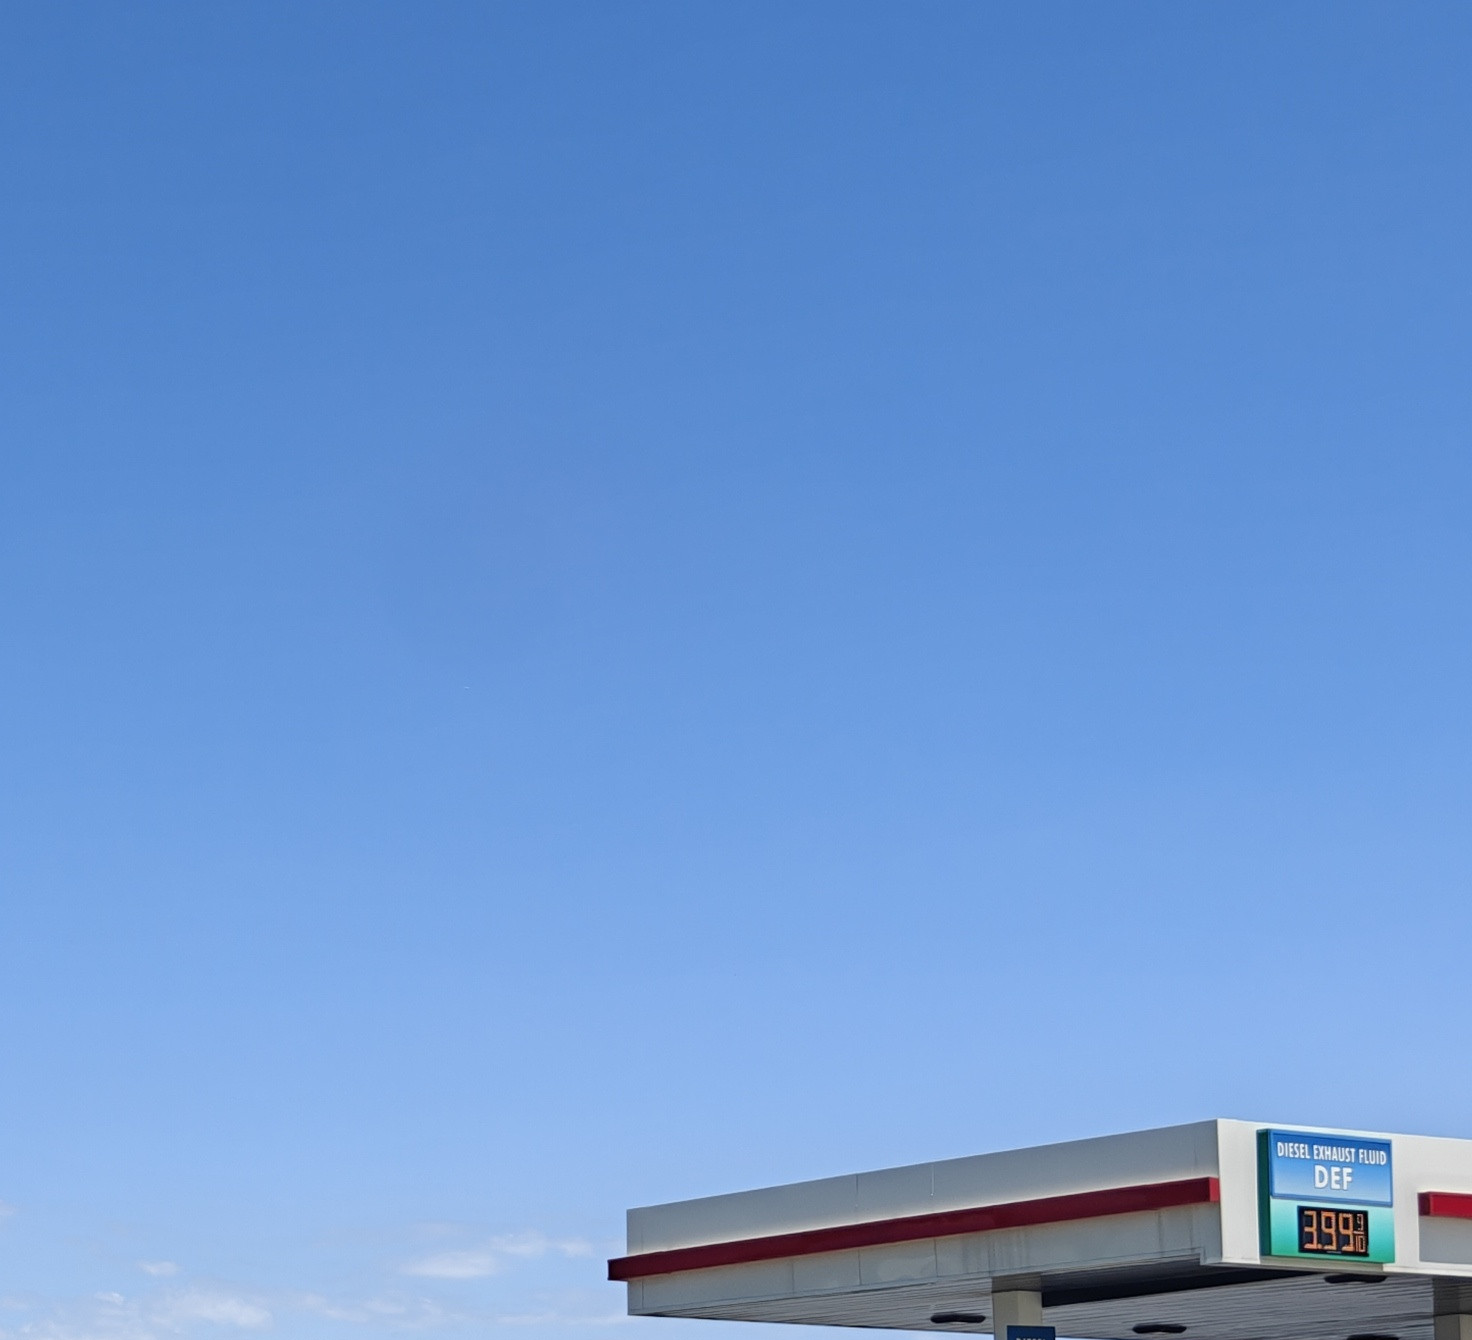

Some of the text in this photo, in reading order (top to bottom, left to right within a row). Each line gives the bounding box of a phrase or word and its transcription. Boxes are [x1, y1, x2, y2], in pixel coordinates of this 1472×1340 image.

[1277, 1142, 1387, 1165] DIESEL EXHAUST FLUID
[1314, 1165, 1353, 1190] DEF
